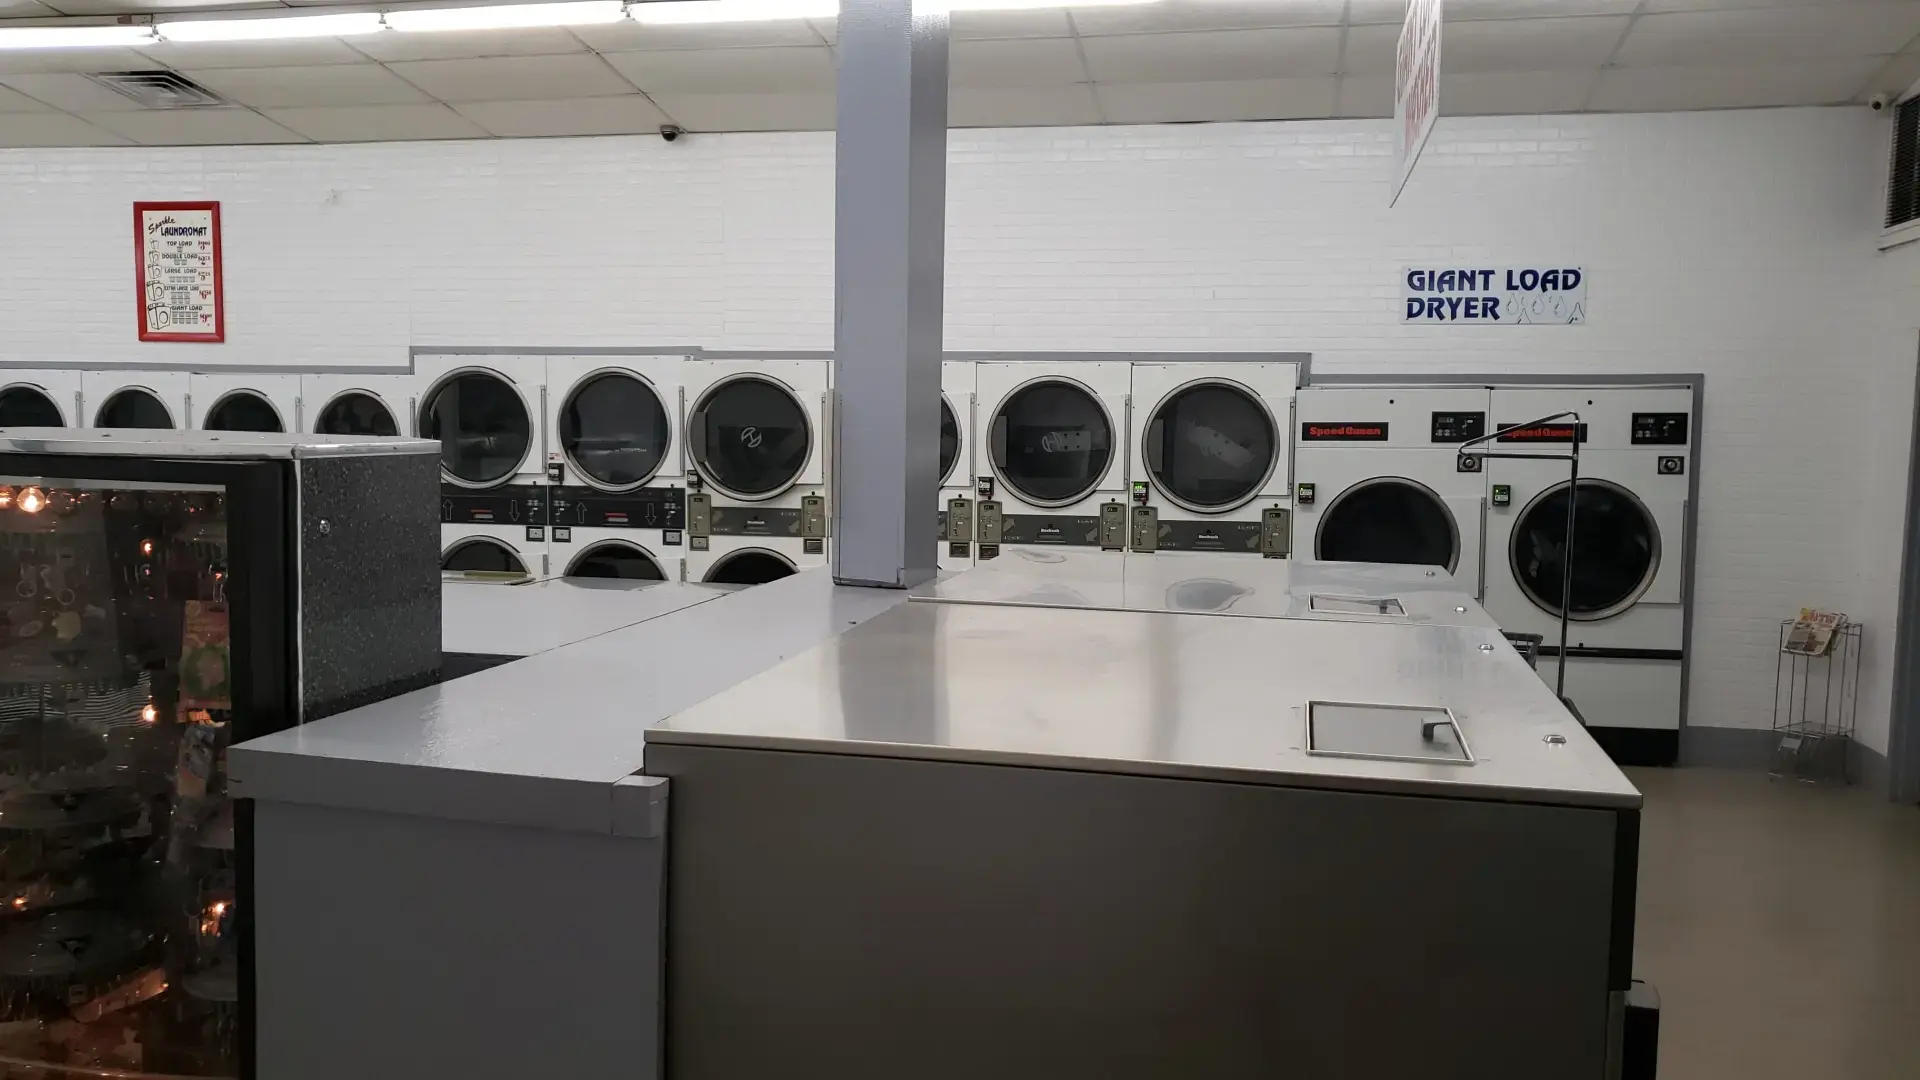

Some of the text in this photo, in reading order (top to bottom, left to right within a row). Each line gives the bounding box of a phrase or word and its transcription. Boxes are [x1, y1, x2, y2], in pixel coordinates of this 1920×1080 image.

[160, 227, 207, 237] LAUNDROMAT
[1407, 268, 1581, 293] GIANT LOAD
[1406, 297, 1500, 321] DRYER
[1309, 426, 1381, 436] Speed Queen
